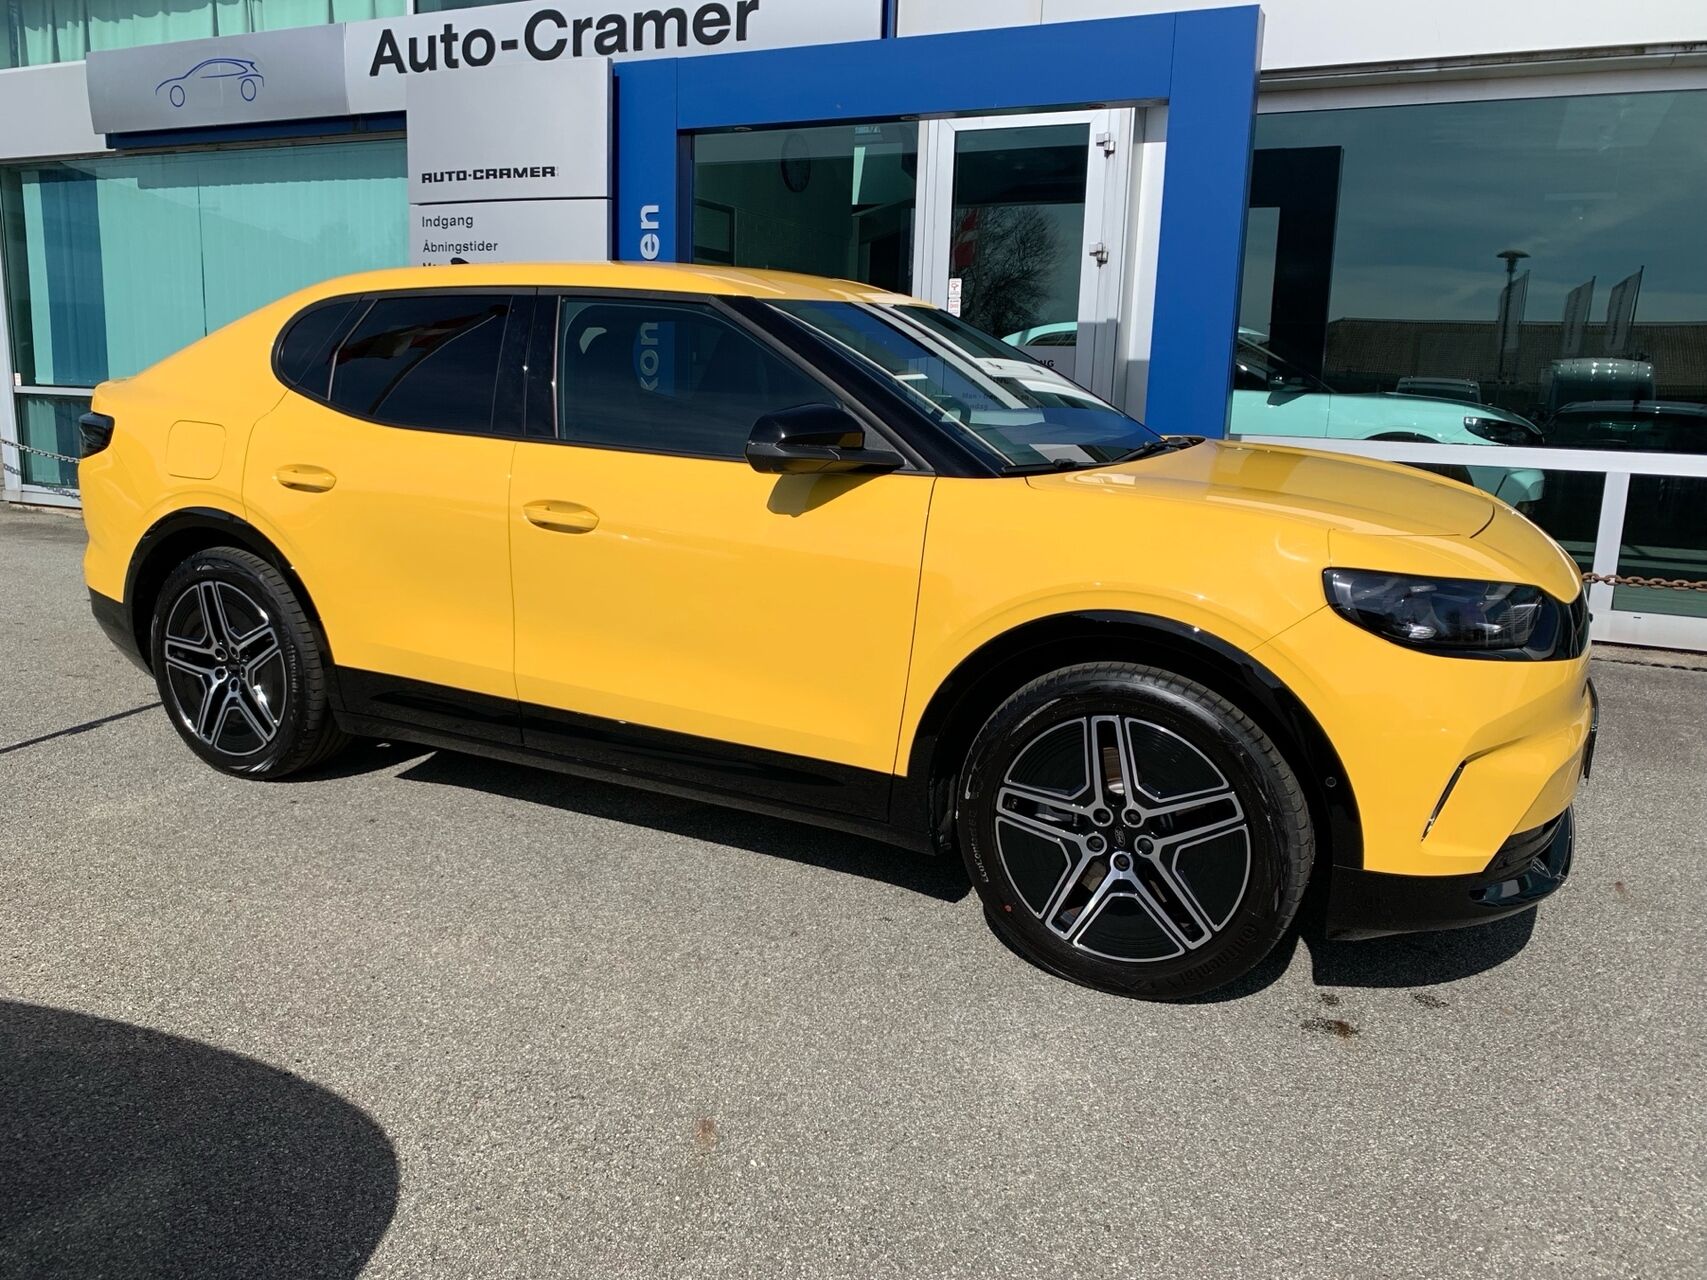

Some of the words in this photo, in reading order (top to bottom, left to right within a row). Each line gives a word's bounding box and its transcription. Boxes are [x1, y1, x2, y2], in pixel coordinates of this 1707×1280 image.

[369, 0, 760, 76] Auto-Cramer
[421, 165, 557, 184] AUTO-CRAMER
[421, 214, 474, 229] Indgang
[422, 239, 499, 254] Åbningstider
